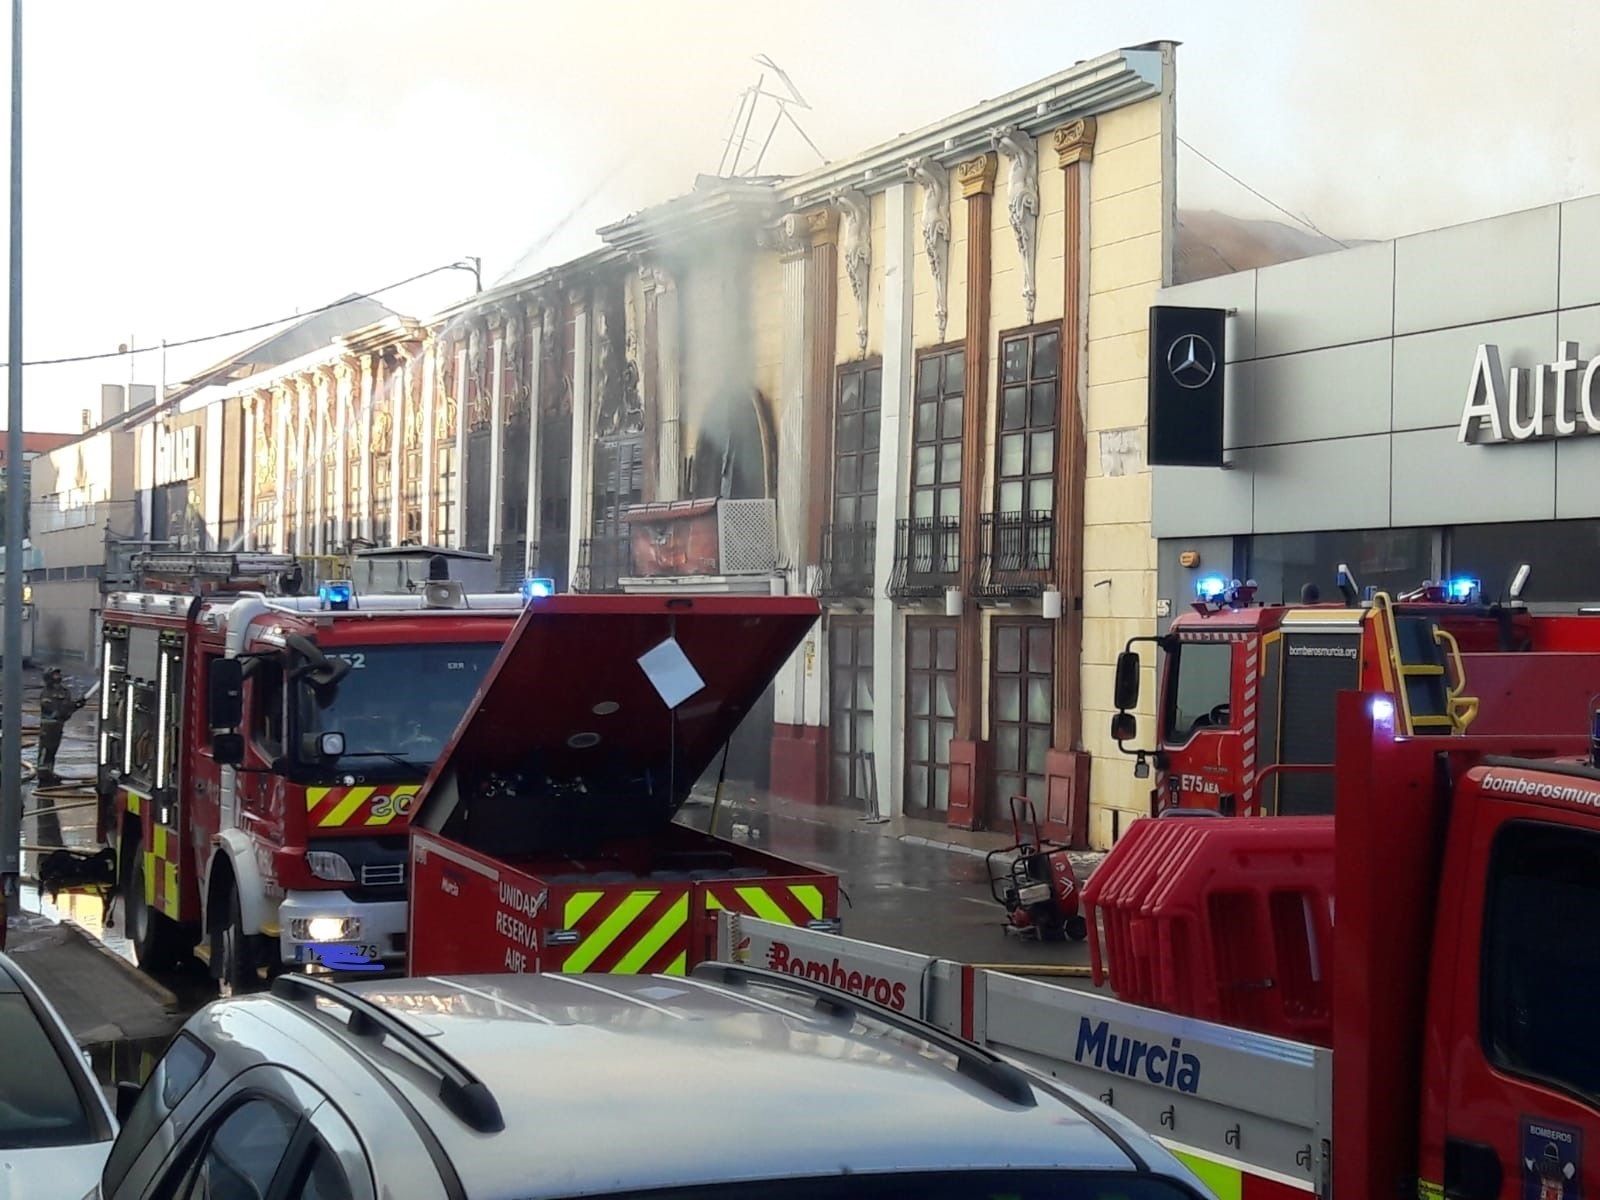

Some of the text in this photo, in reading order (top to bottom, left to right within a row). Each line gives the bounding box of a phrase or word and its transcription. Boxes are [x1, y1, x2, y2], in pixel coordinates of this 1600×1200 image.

[1289, 645, 1358, 660] bomberosmurcia.org
[1181, 774, 1204, 793] E75
[499, 880, 539, 919] UNIDAD
[496, 909, 539, 953] RESERVA
[504, 946, 527, 975] AIRE
[765, 940, 907, 1012] Bomberos
[1075, 1016, 1201, 1094] Murcia
[1529, 1124, 1573, 1144] BOMBEROS
